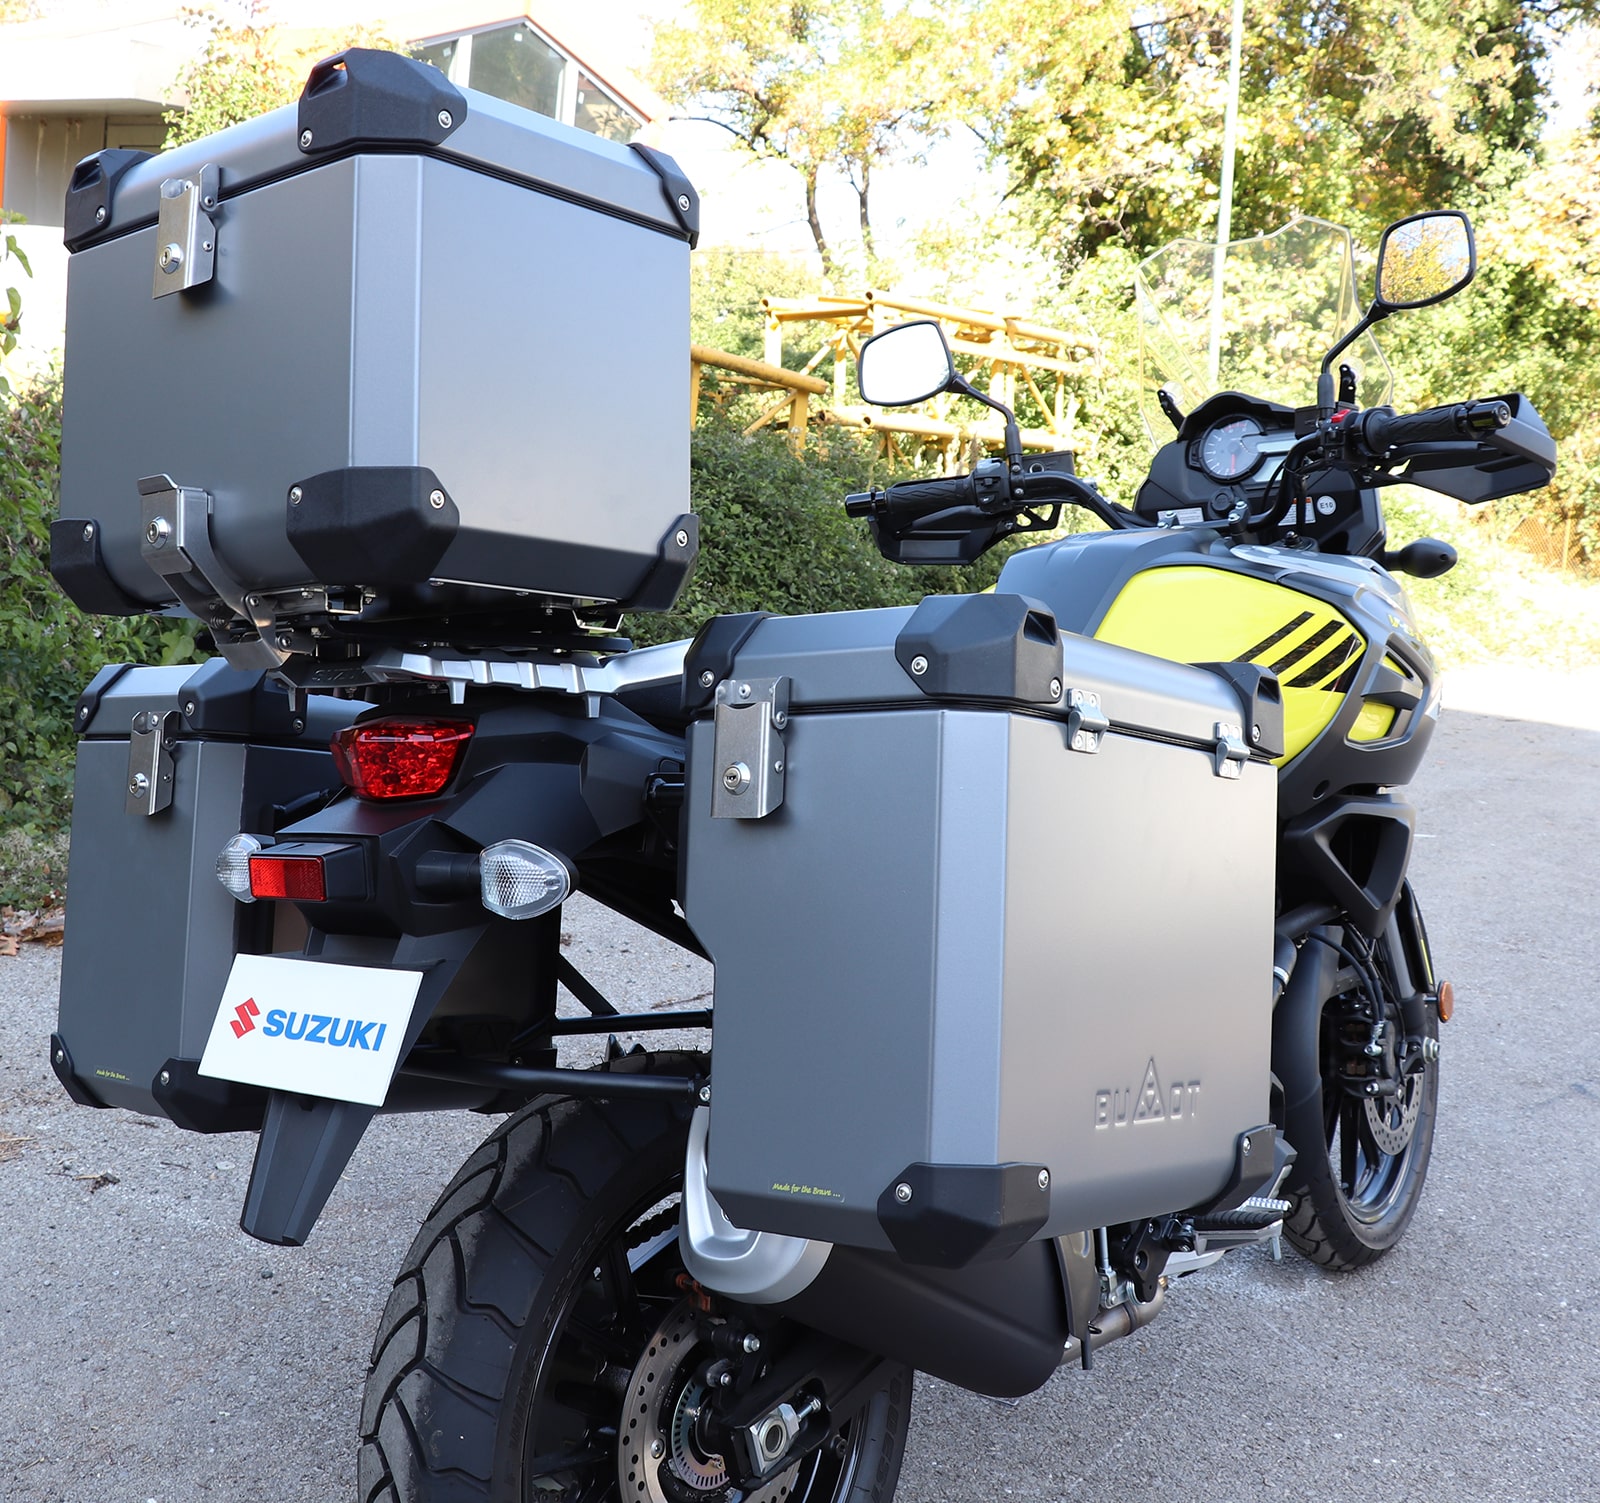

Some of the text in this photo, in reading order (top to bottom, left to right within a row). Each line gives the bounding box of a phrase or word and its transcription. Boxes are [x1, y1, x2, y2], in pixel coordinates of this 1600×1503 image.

[263, 1009, 387, 1051] SUZUKI
[772, 1183, 790, 1191] Made
[791, 1184, 801, 1194] for
[801, 1185, 812, 1194] the
